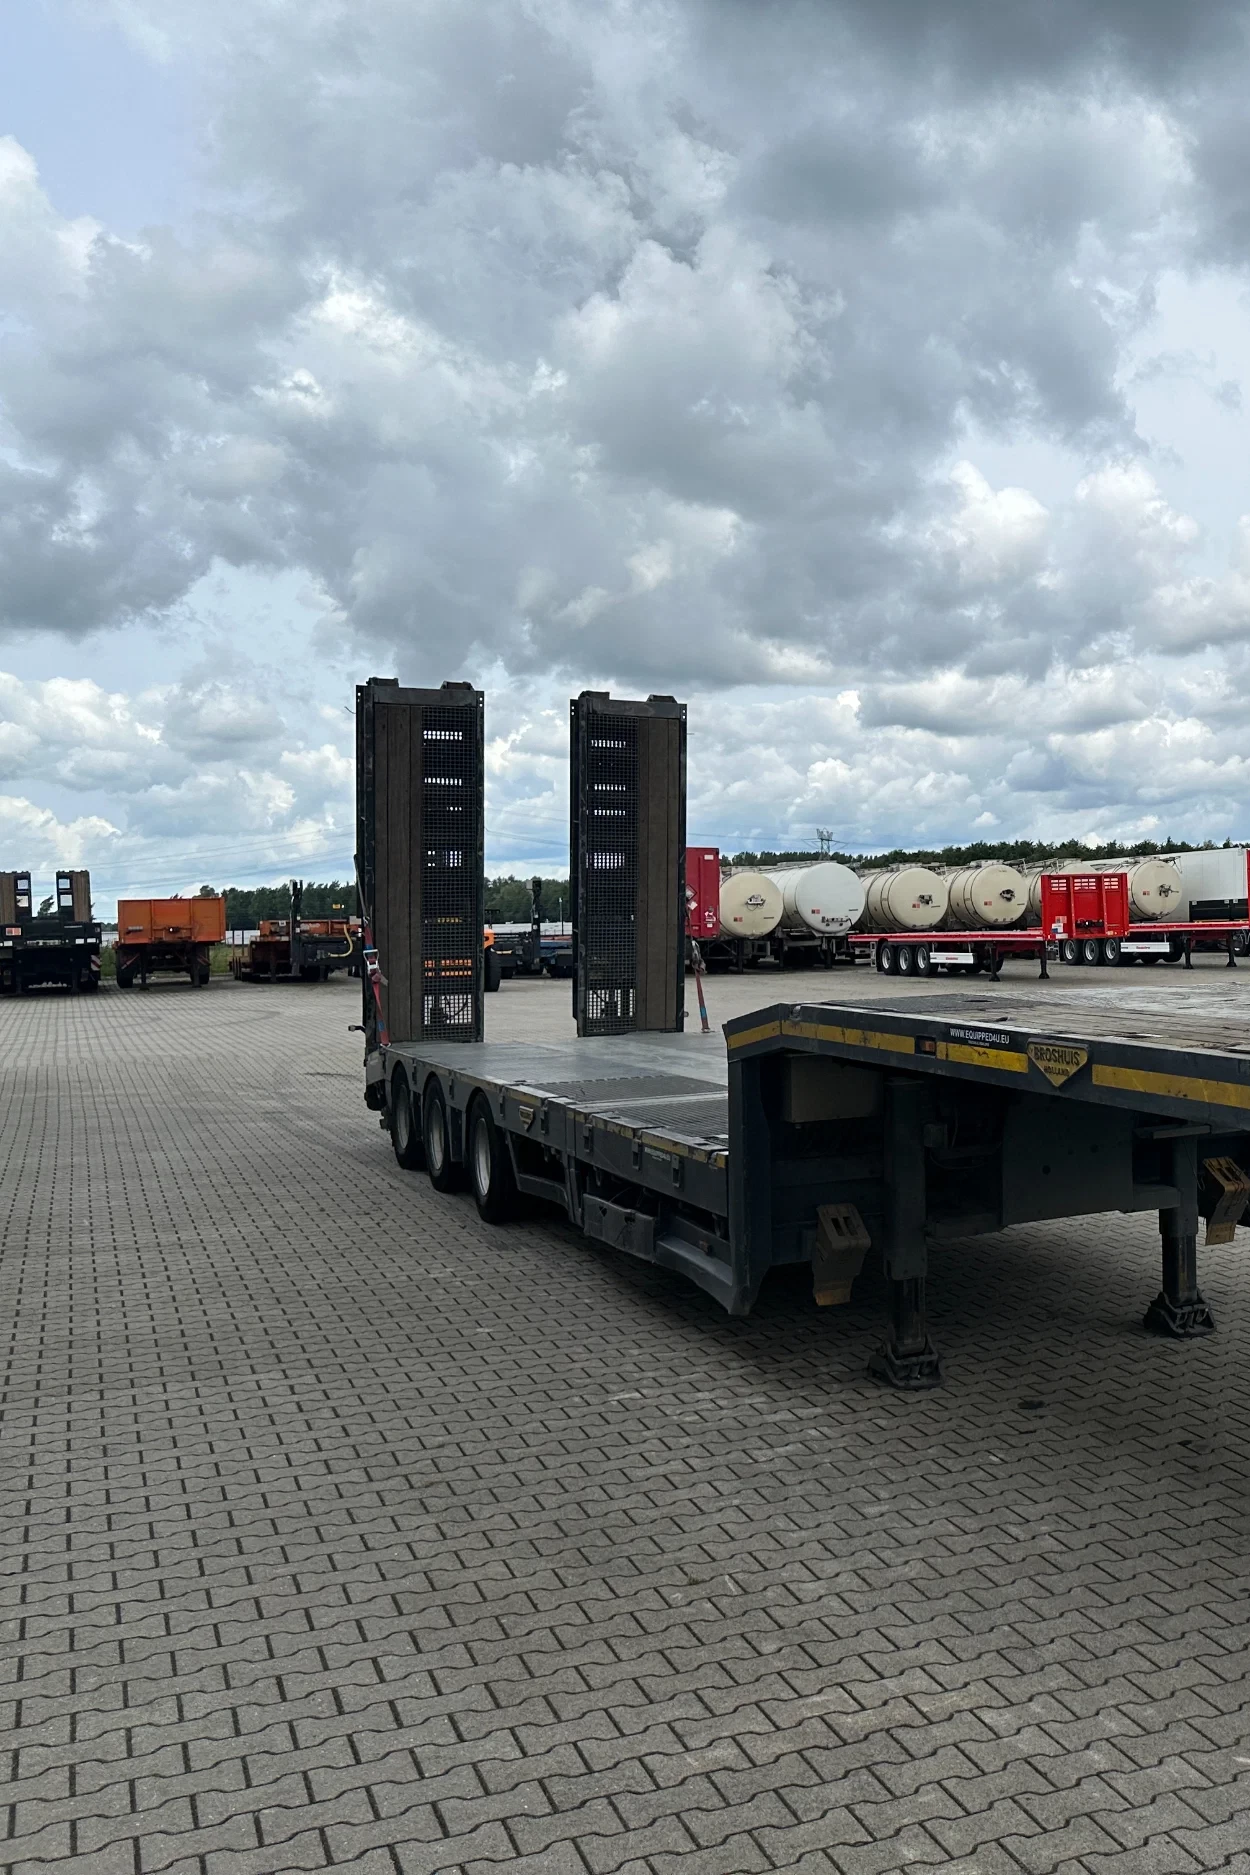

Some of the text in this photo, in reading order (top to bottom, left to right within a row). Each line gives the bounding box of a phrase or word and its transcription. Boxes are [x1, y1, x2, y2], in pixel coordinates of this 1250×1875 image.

[950, 1027, 1010, 1044] WWW.EQUIPPED4U.EU
[1033, 1046, 1080, 1066] BROSHUIS
[1043, 1065, 1070, 1077] HOLLAND
